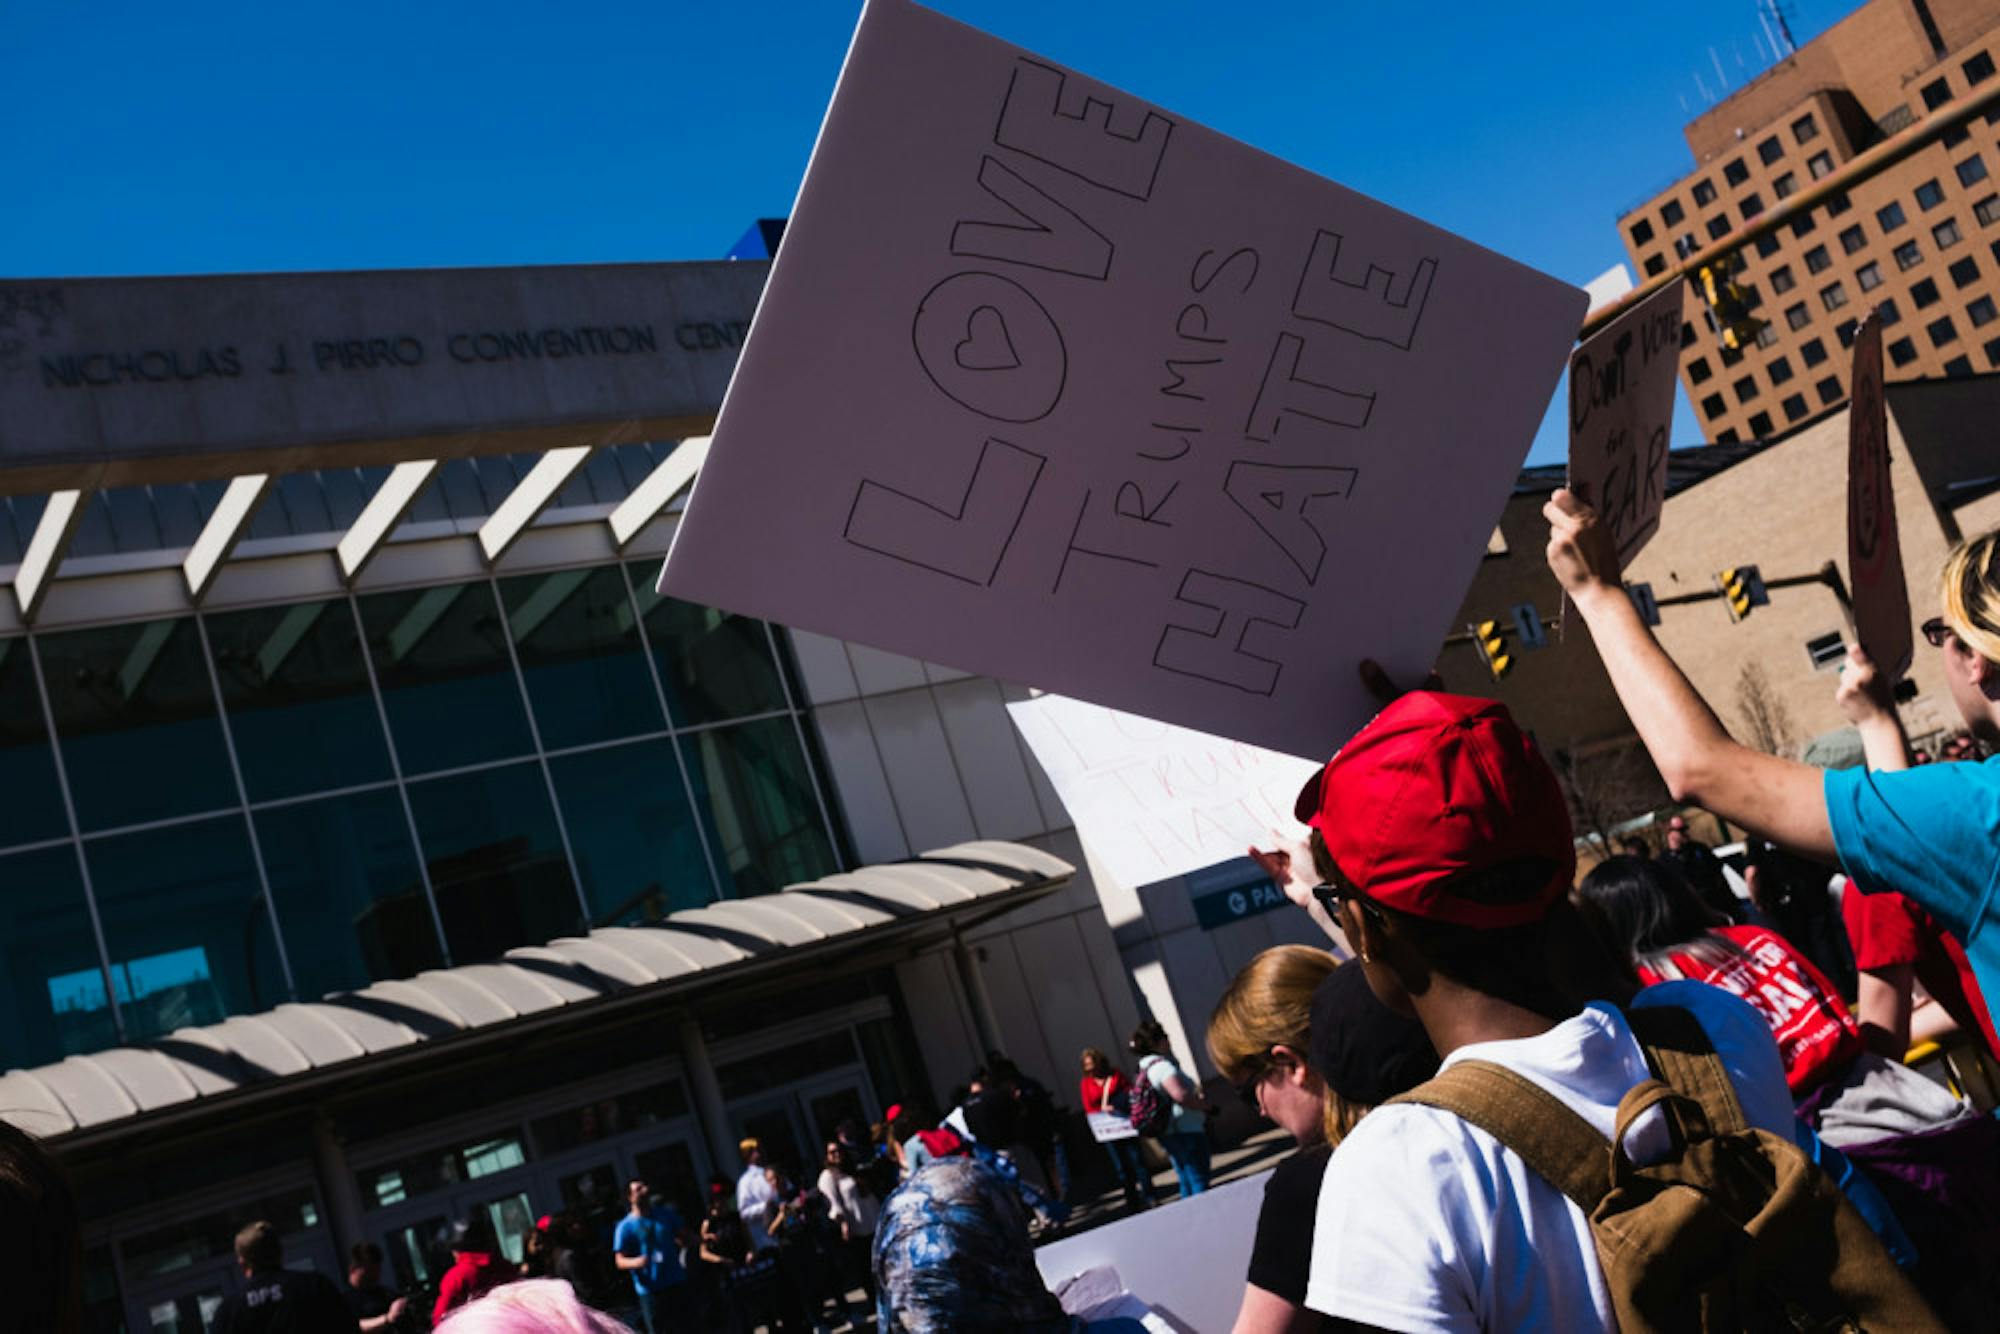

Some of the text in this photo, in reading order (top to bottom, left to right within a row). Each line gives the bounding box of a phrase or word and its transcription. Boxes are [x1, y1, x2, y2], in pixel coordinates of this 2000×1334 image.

[41, 345, 243, 389] NICHOLAS
[313, 335, 425, 373] PIRRO
[448, 324, 657, 364] CONVENTION
[676, 319, 748, 353] CENT
[843, 56, 1176, 588] LOVE
[1052, 247, 1259, 594] TRUMPS
[1154, 228, 1439, 697] HATE
